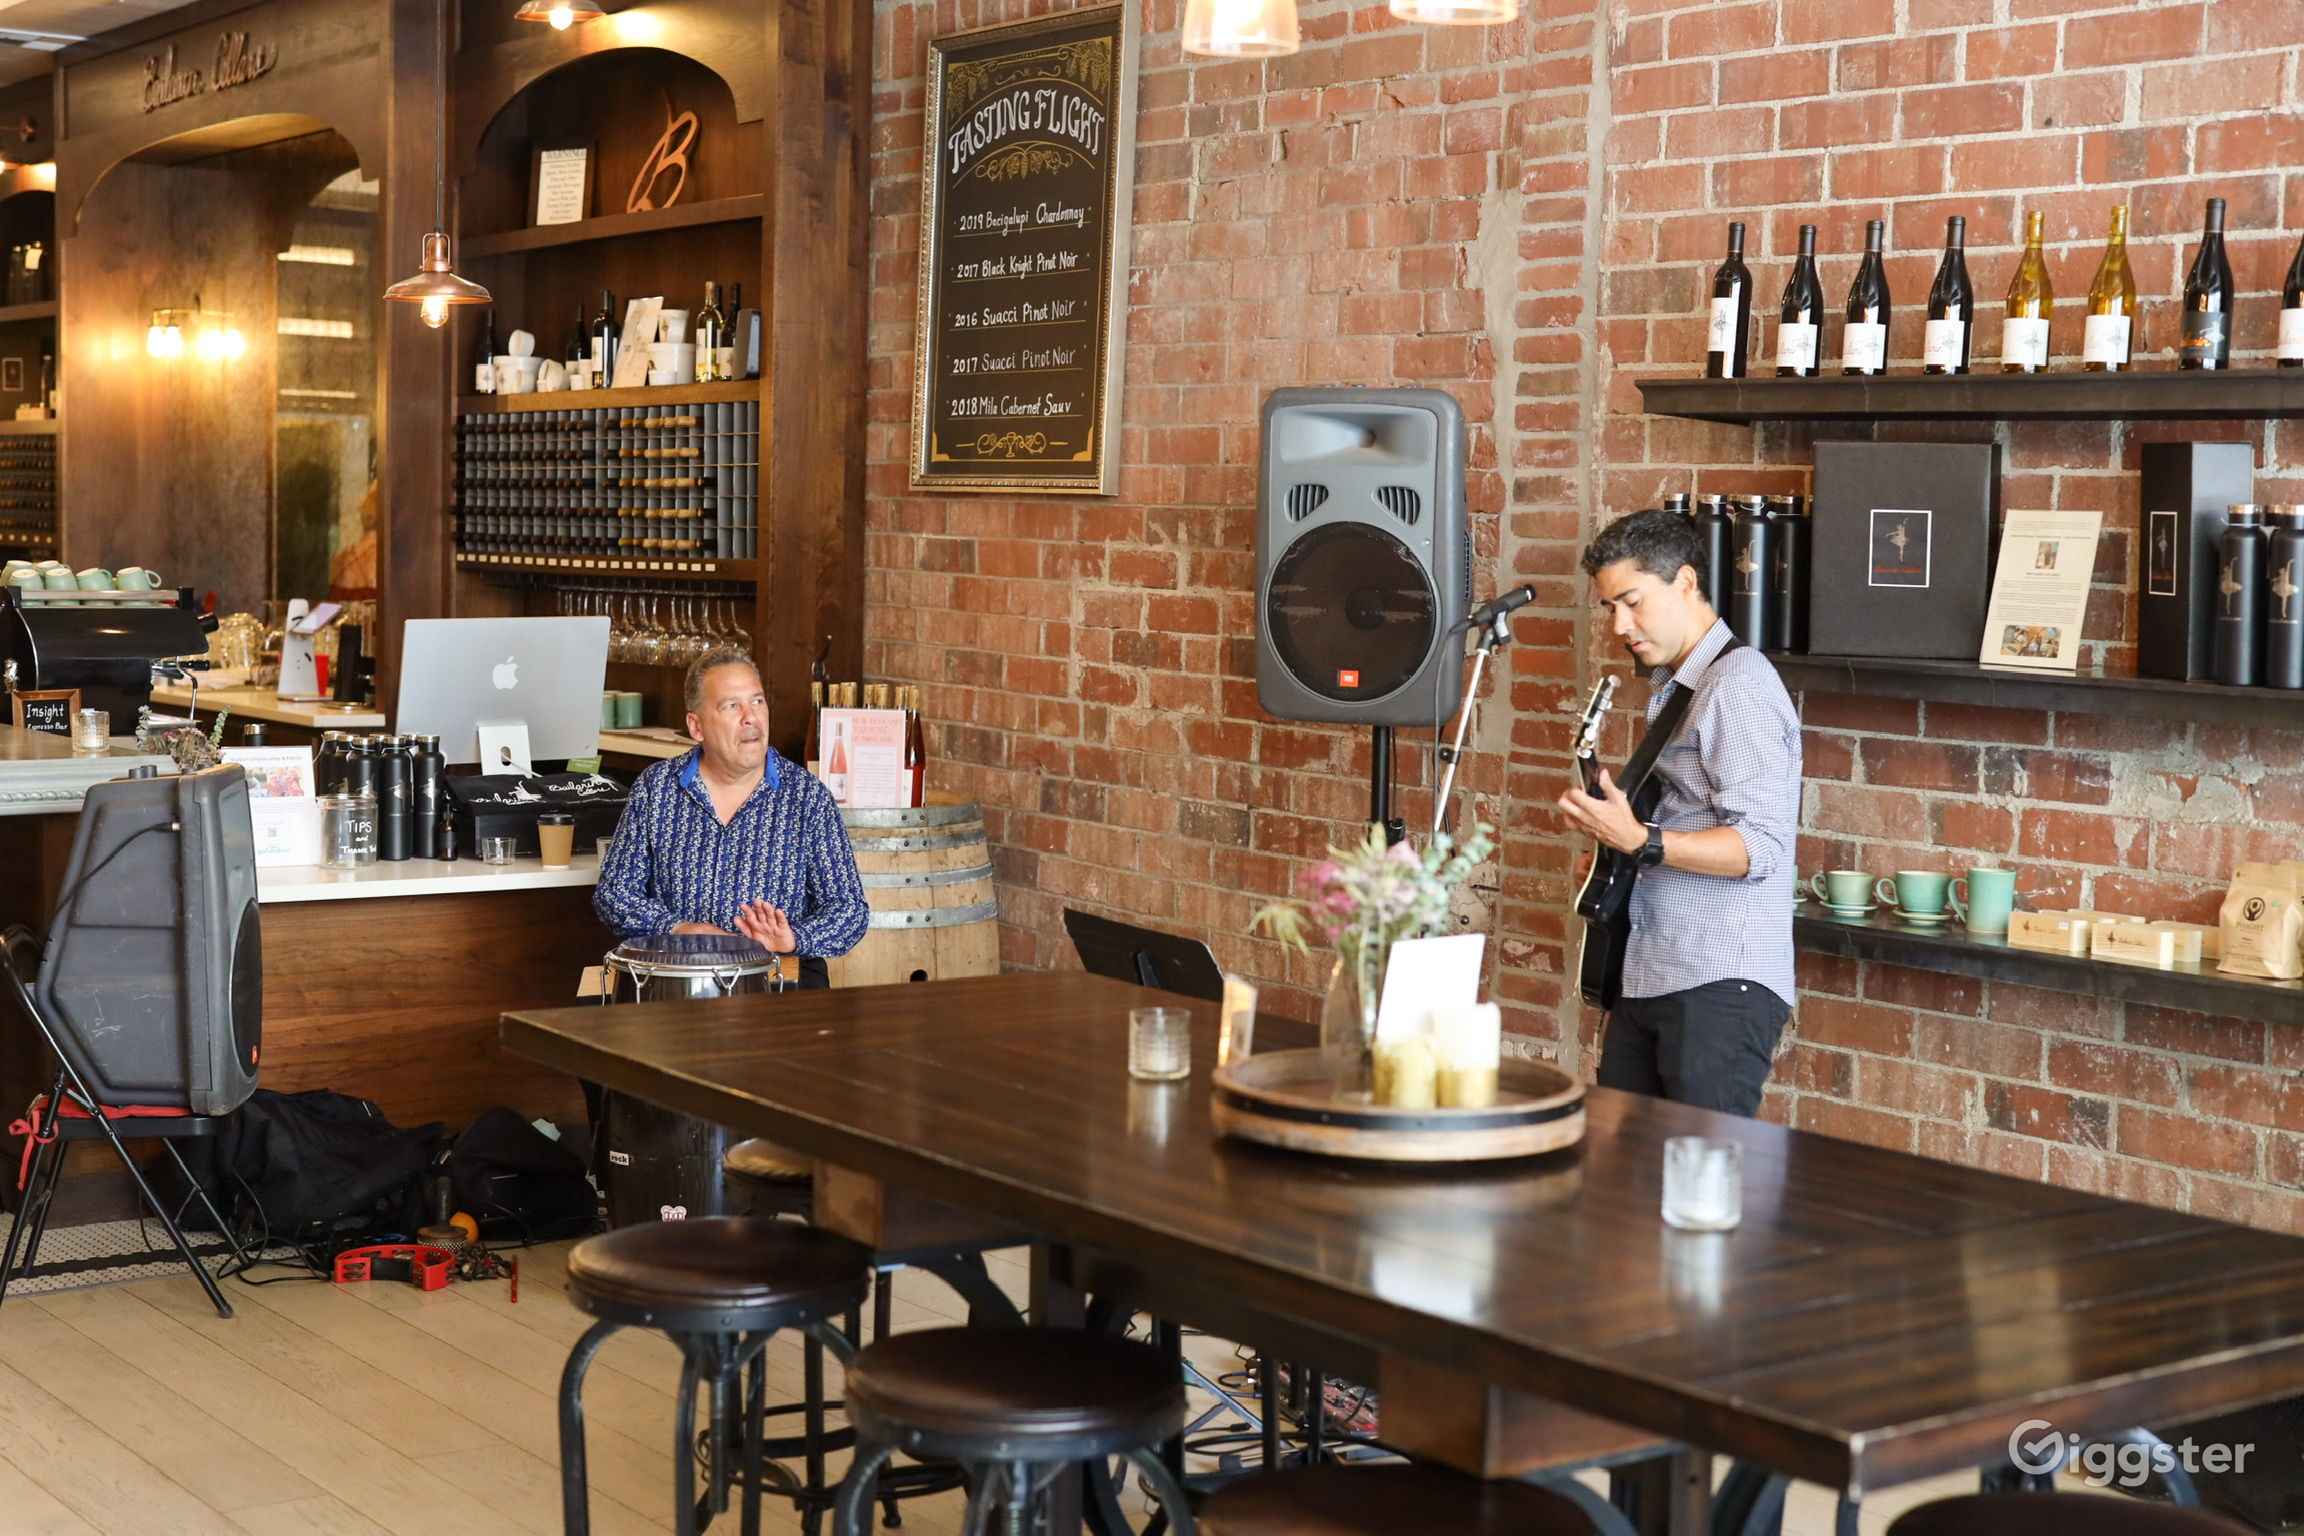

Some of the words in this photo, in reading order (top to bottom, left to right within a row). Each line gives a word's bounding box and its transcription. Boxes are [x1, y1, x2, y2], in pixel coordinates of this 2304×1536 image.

[948, 90, 1030, 174] TASTING
[1034, 89, 1105, 155] FLIGHT
[960, 214, 984, 231] 2019
[986, 206, 1029, 236] Bacigalupi
[1036, 202, 1085, 228] Chardonnay
[957, 263, 979, 279] 2017
[981, 259, 1006, 277] Black
[1009, 255, 1033, 279] Knight
[1036, 252, 1057, 273] Pinot
[1059, 250, 1079, 269] Noir
[955, 312, 978, 327] 2016
[982, 307, 1018, 326] Suacci
[1022, 301, 1049, 323] Pinot
[1051, 299, 1076, 320] Noir
[953, 356, 978, 374] 2017
[981, 352, 1017, 372] Suacci
[1022, 349, 1051, 370] Pinot
[1052, 345, 1077, 365] Noir
[951, 397, 978, 417] 2018
[979, 396, 998, 416] Mila
[1001, 395, 1042, 416] Cabernet
[1043, 392, 1072, 417] Sauv
[26, 703, 65, 723] Insight
[55, 721, 68, 730] Bar
[343, 819, 372, 833] TIPS
[339, 845, 368, 854] THANK
